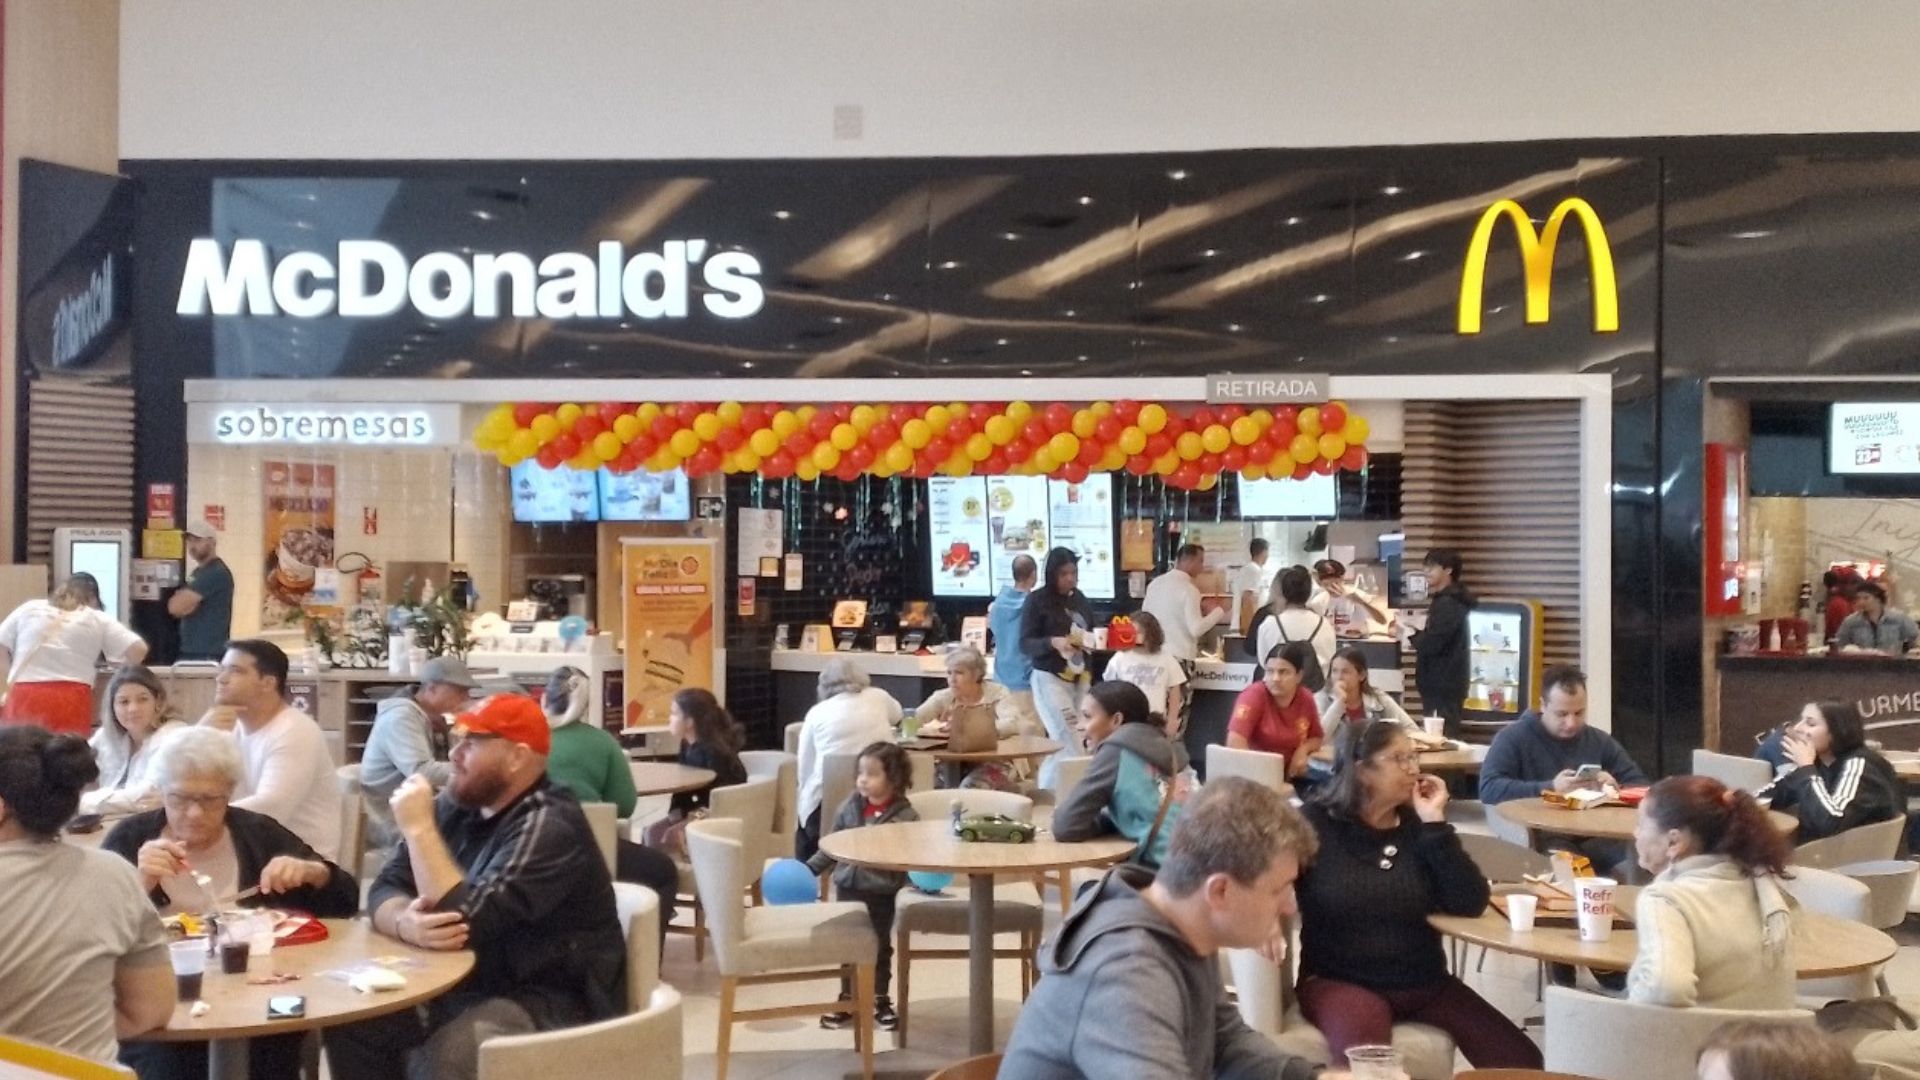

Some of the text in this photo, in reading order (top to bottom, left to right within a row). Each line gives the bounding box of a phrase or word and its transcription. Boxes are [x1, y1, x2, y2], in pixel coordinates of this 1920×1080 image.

[176, 238, 764, 318] McDonald's
[1216, 380, 1318, 397] RETIRADA
[216, 407, 426, 439] sobremesas
